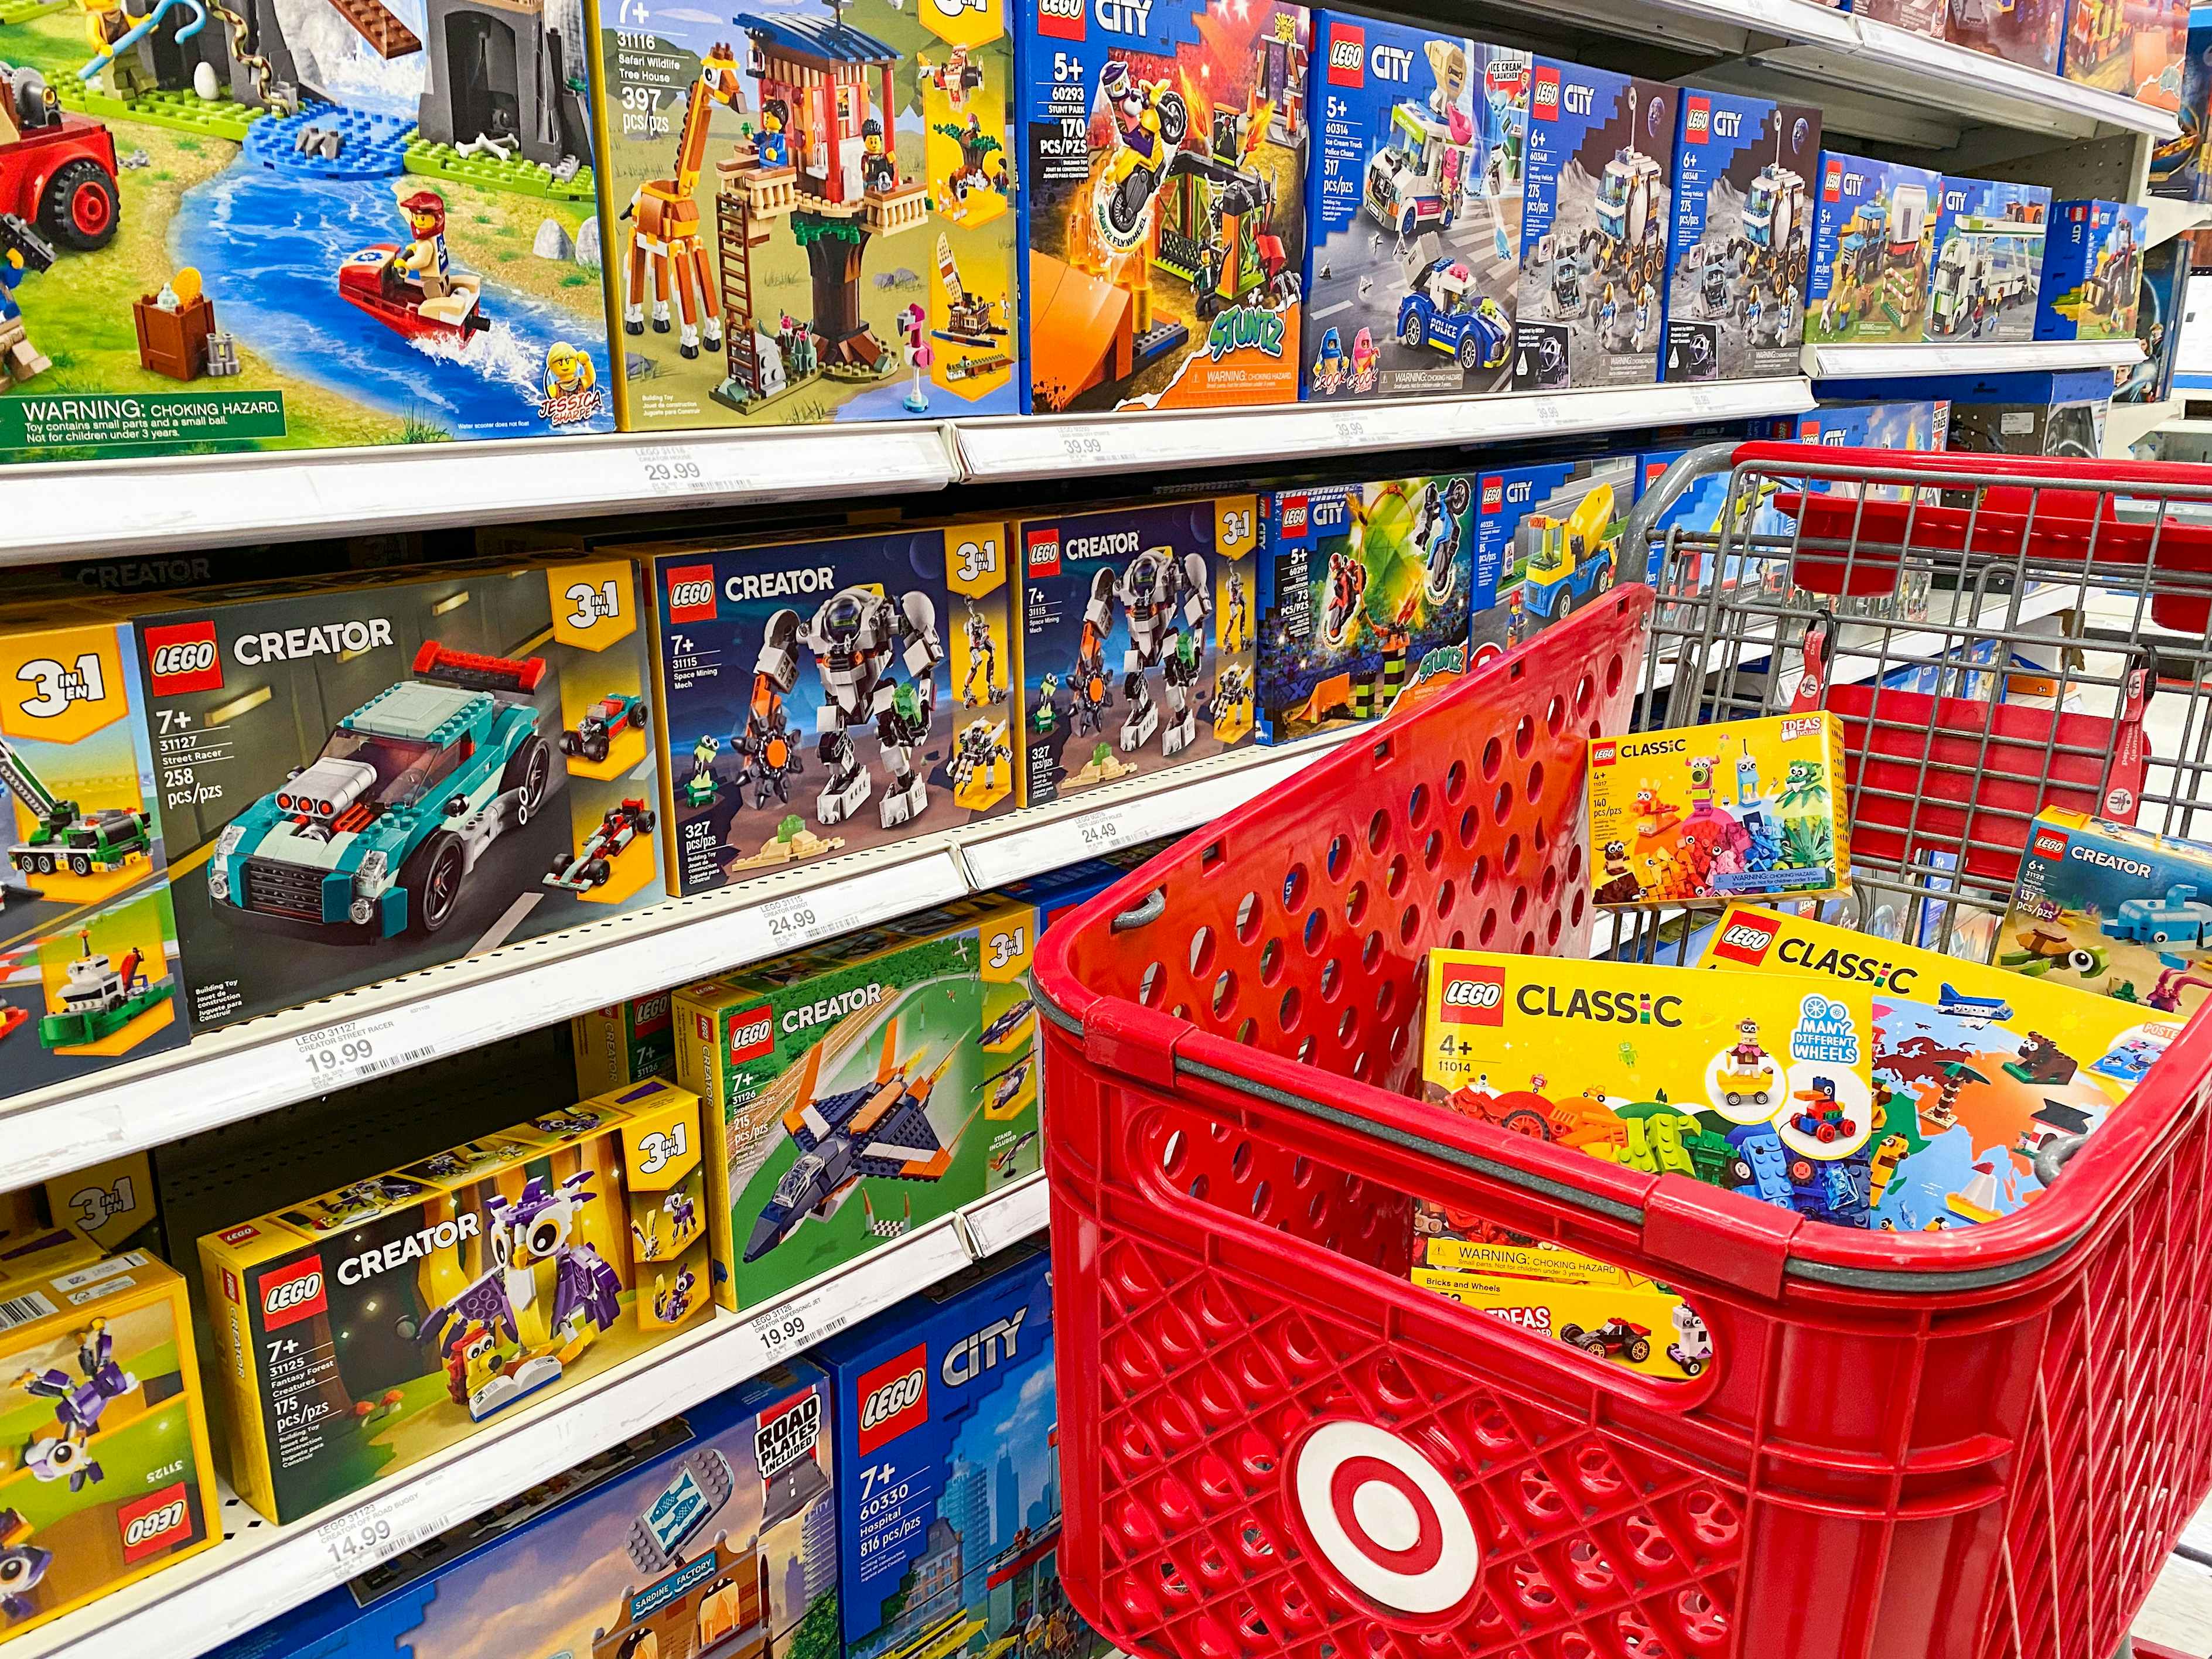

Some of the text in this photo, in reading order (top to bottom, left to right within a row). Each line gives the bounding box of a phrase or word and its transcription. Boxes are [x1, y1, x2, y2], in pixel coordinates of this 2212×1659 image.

[617, 31, 656, 50] 31116
[618, 53, 680, 70] Safari Wildlife
[1054, 53, 1083, 81] 5+
[1370, 45, 1414, 83] CITY
[619, 69, 670, 83] Tree House
[622, 87, 661, 111] 397
[1052, 87, 1084, 101] 60293
[1049, 104, 1085, 114] STUNT PARK
[1326, 97, 1347, 118] 5+
[623, 110, 669, 136] pcs/pzs
[1060, 118, 1085, 138] 170
[1326, 122, 1348, 135] 60314
[1688, 111, 1742, 138] LEGO CITY
[1349, 141, 1363, 149] Truck
[1531, 129, 1545, 147] 6+
[1324, 159, 1339, 176] 317
[1683, 152, 1696, 168] 6+
[1528, 184, 1540, 198] 275
[1825, 173, 1865, 196] LEGO CITY
[1527, 197, 1548, 214] pcs/pzs
[1680, 200, 1691, 212] 275
[1945, 190, 1967, 211] CITY
[1679, 212, 1699, 226] pcs/pzs
[1821, 210, 1831, 223] 5+
[1430, 318, 1459, 339] POLICE
[22, 398, 280, 422] WARNING: CHOKING HAZARD.
[538, 391, 602, 418] JESSICA
[25, 417, 206, 433] Toy contains small parts and small
[552, 409, 591, 425] SHARPE
[26, 430, 139, 443] Not for children under
[1064, 439, 1101, 454] 39.99
[644, 462, 701, 480] 29.99
[1312, 500, 1347, 526] CITY
[1029, 531, 1139, 565] LEGO CREATOR
[1291, 547, 1308, 564] 5+
[1289, 565, 1308, 576] 60299
[671, 566, 834, 607] LEGO CREATOR
[1298, 589, 1308, 602] 73
[1029, 588, 1044, 606] 7+
[1029, 606, 1047, 616] 31115
[1281, 600, 1309, 616] PCS/PZS
[1029, 616, 1059, 627] Space Mining
[1029, 626, 1043, 634] Mech
[153, 618, 394, 675] LEGO CREATOR
[671, 634, 694, 655] 7+
[673, 657, 697, 669] 31115
[674, 671, 695, 681] Space
[675, 681, 692, 689] Mech
[156, 710, 192, 735] 7+
[1781, 717, 1821, 732] IDEAS
[159, 736, 197, 752] 31127
[1032, 745, 1050, 760] 327
[162, 749, 222, 766] Street Racer
[1593, 748, 1614, 760] LEGO
[1032, 757, 1053, 773] pcs/pzs
[164, 767, 194, 788] 258
[168, 782, 223, 810] pcs/pzs
[1593, 798, 1606, 807] 140
[1594, 806, 1622, 819] pcs/pzs
[685, 821, 711, 838] 327
[1082, 823, 1116, 844] 24.49
[686, 835, 716, 854] pcs/pzs
[2028, 861, 2045, 871] 6+
[2035, 837, 2152, 879] LEGO CREATOR
[1732, 873, 1769, 882] WARNING:
[2026, 871, 2044, 881] 31128
[760, 895, 803, 913] LEGO 31115
[2020, 890, 2036, 902] 137
[2016, 902, 2053, 919] pcs/pzs
[769, 909, 815, 936] 24.99
[1723, 926, 1770, 950] LEGO
[196, 984, 224, 995] Building
[197, 994, 216, 1003] Jouet
[1445, 981, 1501, 1007] LEGO
[198, 994, 240, 1008] construction
[227, 1001, 242, 1009] para
[781, 982, 882, 1034] CREATOR
[200, 1009, 231, 1022] Construir
[295, 1022, 356, 1046] LEGO 31127
[1803, 1019, 1851, 1035] MANY
[299, 1021, 394, 1053] CREATOR STREET RACER
[1439, 1034, 1472, 1056] 4+
[1795, 1033, 1855, 1048] DIFFERENT
[305, 1039, 373, 1073] 19.99
[1794, 1044, 1856, 1063] WHEELS
[1438, 1060, 1471, 1073] 11014
[732, 1073, 753, 1093] 7+
[732, 1090, 756, 1105] 31126
[733, 1115, 750, 1131] 215
[994, 1129, 1012, 1143] STAND
[265, 1212, 480, 1313] LEGO CREATOR
[1459, 1247, 1576, 1269] WARNING: CHOKING
[1426, 1278, 1451, 1287] Bricks
[1471, 1283, 1500, 1292] Wheels
[751, 1304, 792, 1328] LEGO 31126
[755, 1298, 821, 1333] CREATOR JET
[760, 1317, 804, 1349] 19.99
[267, 1338, 299, 1363] 7+
[269, 1358, 305, 1378] 31125
[307, 1360, 334, 1376] Forest
[862, 1306, 1029, 1430] LEGO CITY
[272, 1377, 316, 1398] Creatures
[274, 1396, 298, 1416] 175
[759, 1397, 817, 1454] ROAD
[760, 1418, 817, 1468] PLATES
[764, 1435, 813, 1474] INCLUDED
[859, 1463, 895, 1501] 7+
[373, 1492, 419, 1518] ROAD BUGGY
[860, 1483, 909, 1521] 60330
[860, 1506, 902, 1538] Hospital
[328, 1519, 391, 1562] 14.99
[861, 1535, 880, 1558] 816
[635, 1558, 712, 1610] SARDINE FACTORY
